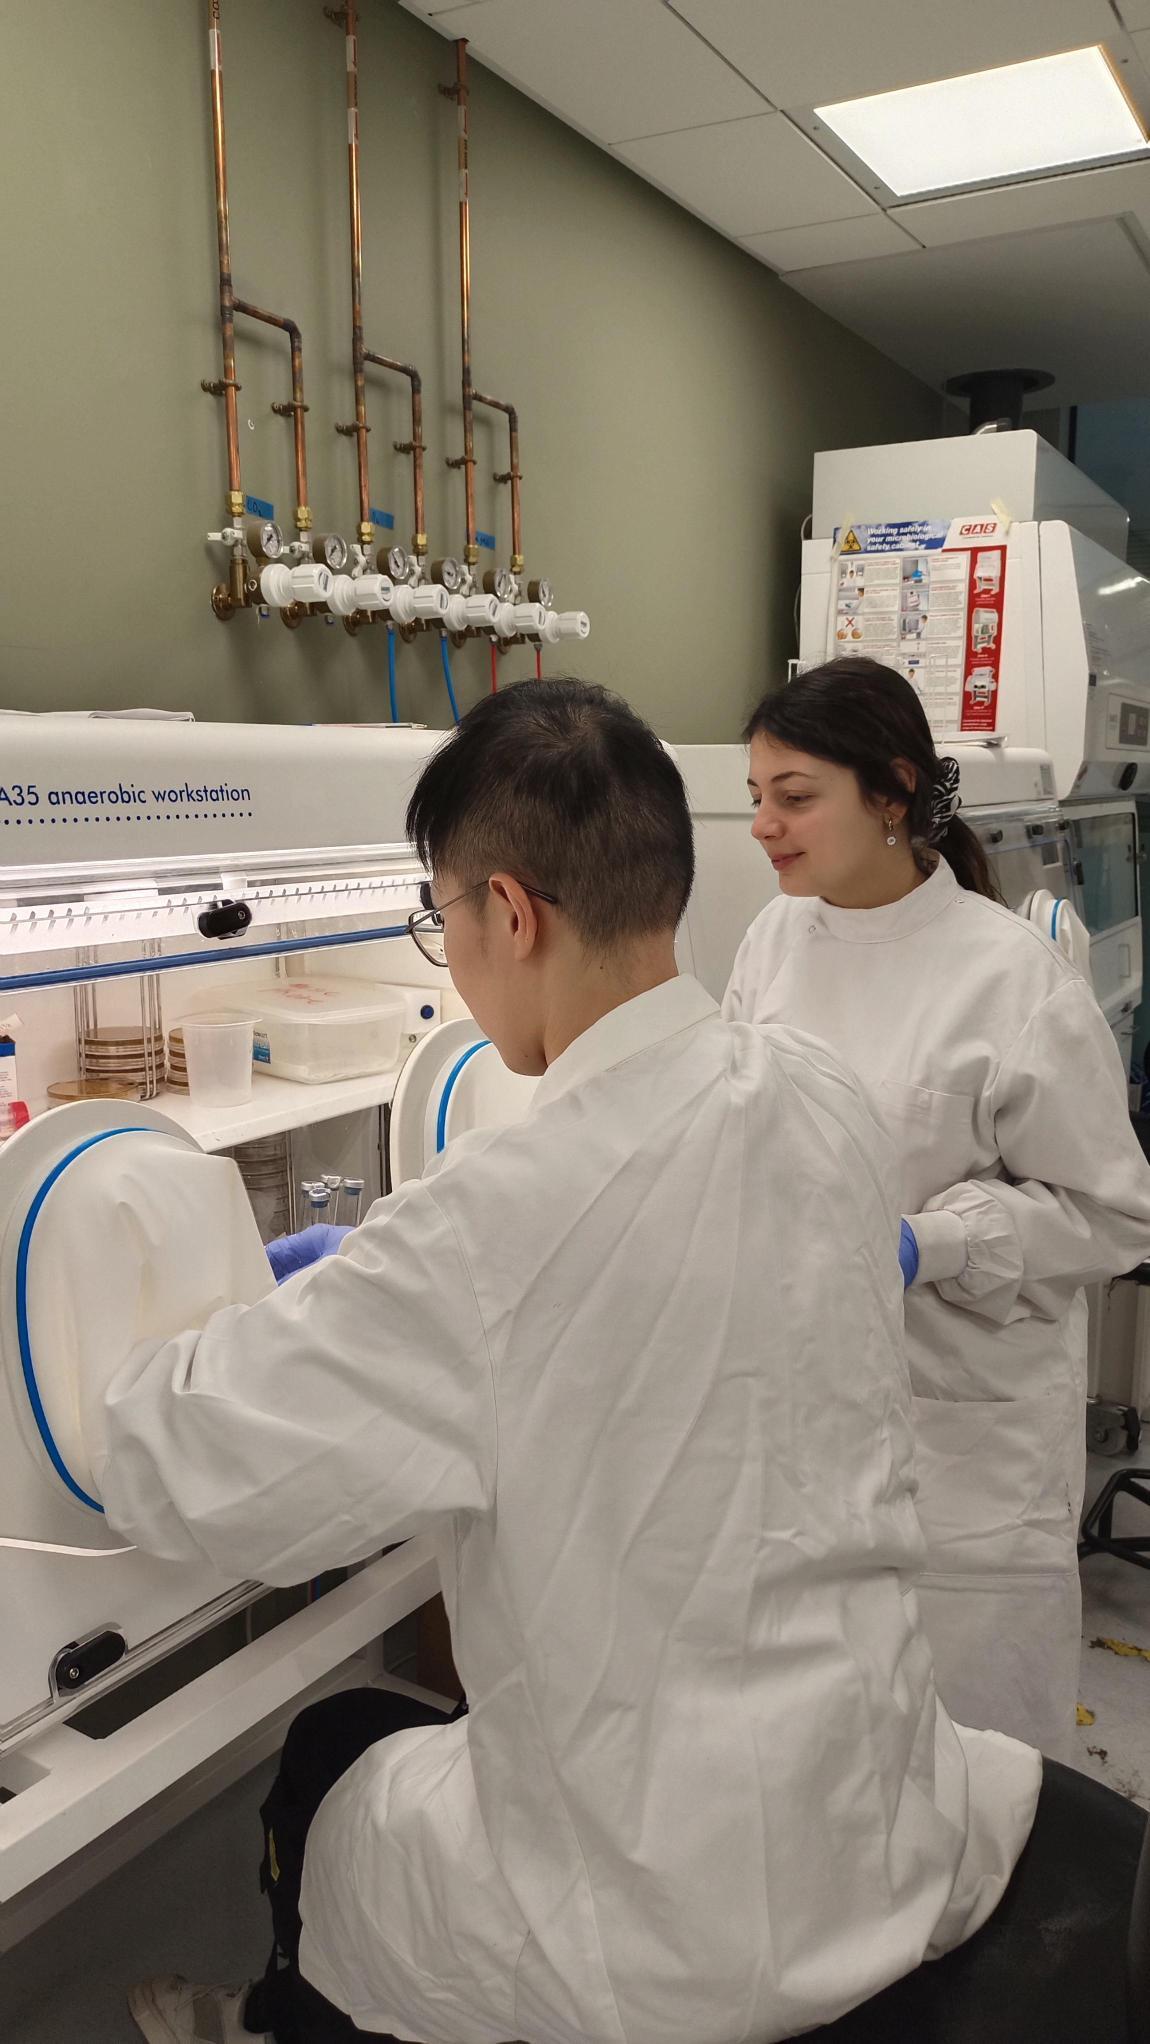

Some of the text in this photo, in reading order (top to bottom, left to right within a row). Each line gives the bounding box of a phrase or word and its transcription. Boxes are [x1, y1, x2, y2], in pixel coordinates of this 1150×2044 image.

[867, 527, 898, 536] Working
[899, 525, 921, 535] safely
[960, 523, 997, 535] CAS
[866, 536, 884, 544] your
[866, 543, 890, 551] safety
[47, 783, 147, 805] anaerobic
[152, 783, 251, 803] workstation
